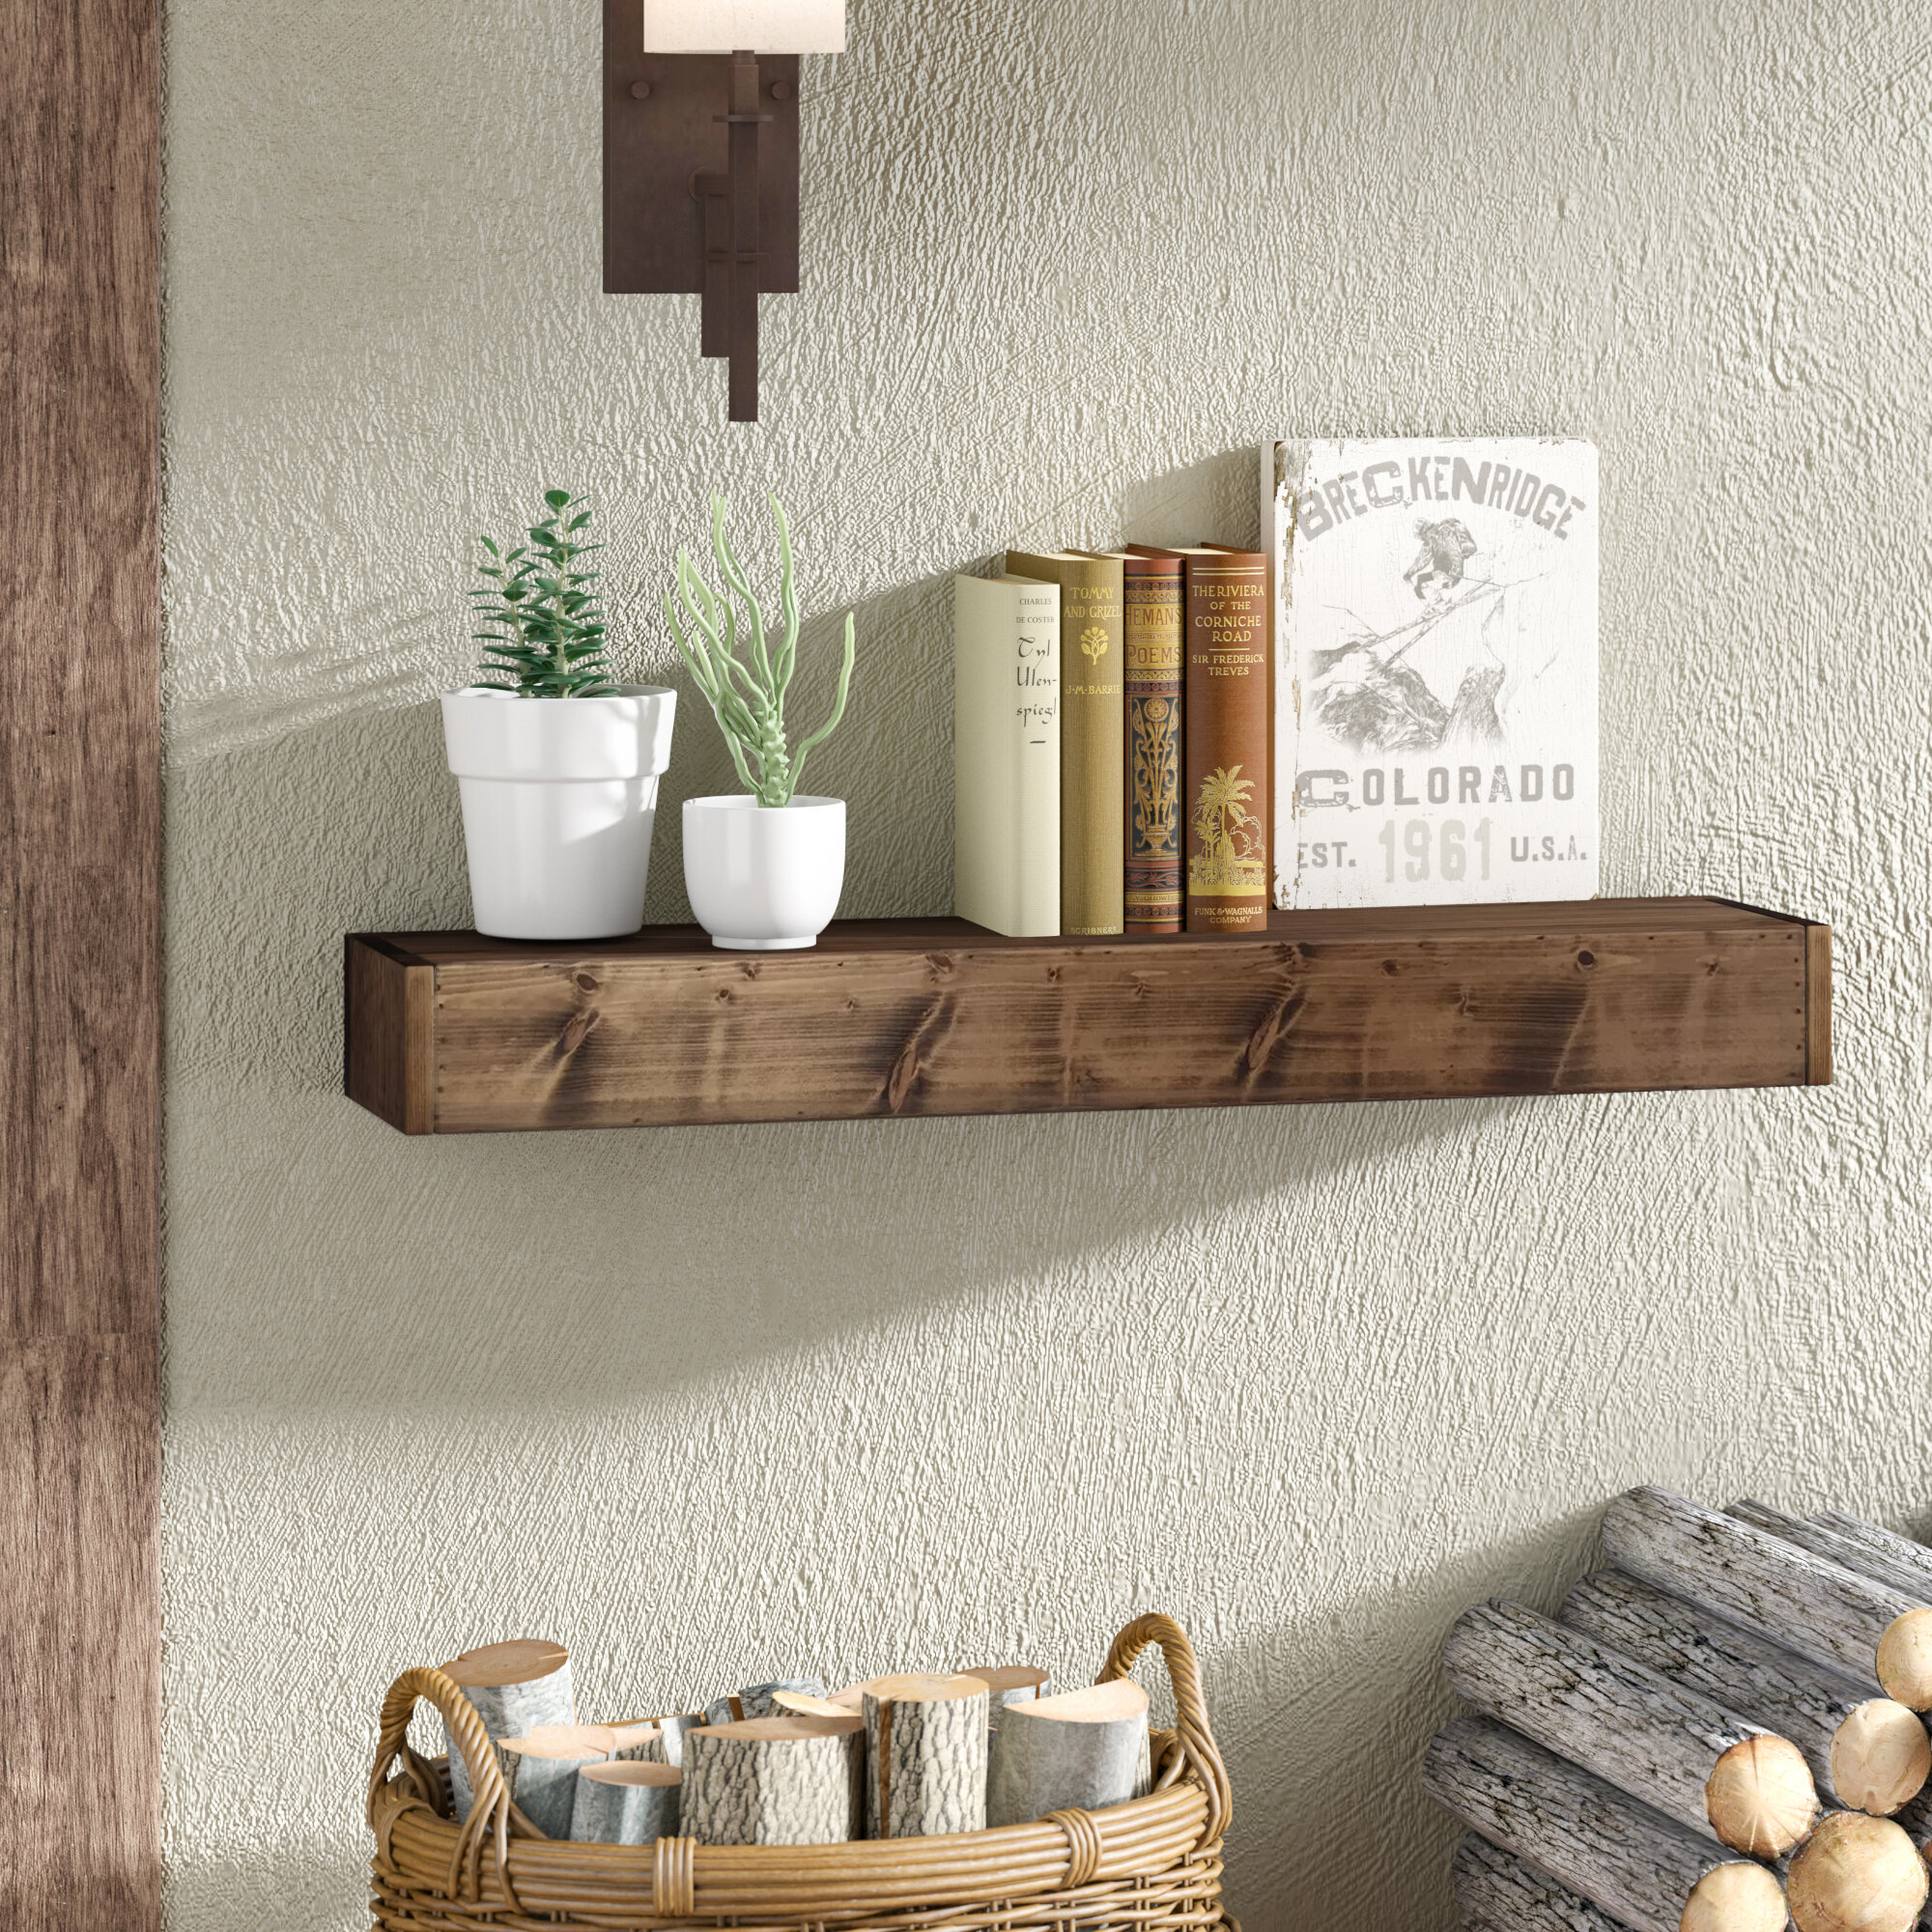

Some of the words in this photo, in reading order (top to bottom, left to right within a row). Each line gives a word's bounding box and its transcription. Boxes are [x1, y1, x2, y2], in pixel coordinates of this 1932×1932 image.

[1292, 456, 1586, 542] BRECKENRIDGE
[1070, 586, 1115, 600] TOMMY
[1217, 584, 1264, 597] RIVIERA
[1064, 606, 1086, 618] AND
[1089, 605, 1122, 620] GRIZEL
[1209, 602, 1226, 611] OF
[1231, 601, 1252, 611] THE
[1124, 605, 1182, 627] HEMANS
[1194, 615, 1262, 628] CORNICHE
[1211, 630, 1252, 642] ROAD
[1125, 643, 1181, 667] POEMS
[1192, 655, 1209, 664] SIR
[1213, 654, 1264, 664] FREDERICK
[1208, 667, 1249, 676] TREVES
[1295, 763, 1575, 812] COLORADO
[1378, 817, 1492, 884] 1961
[1510, 835, 1587, 863] U.S.A.
[1194, 907, 1215, 916] FUNK
[1224, 906, 1264, 916] WAGNALLS
[1209, 915, 1252, 923] COMPANY
